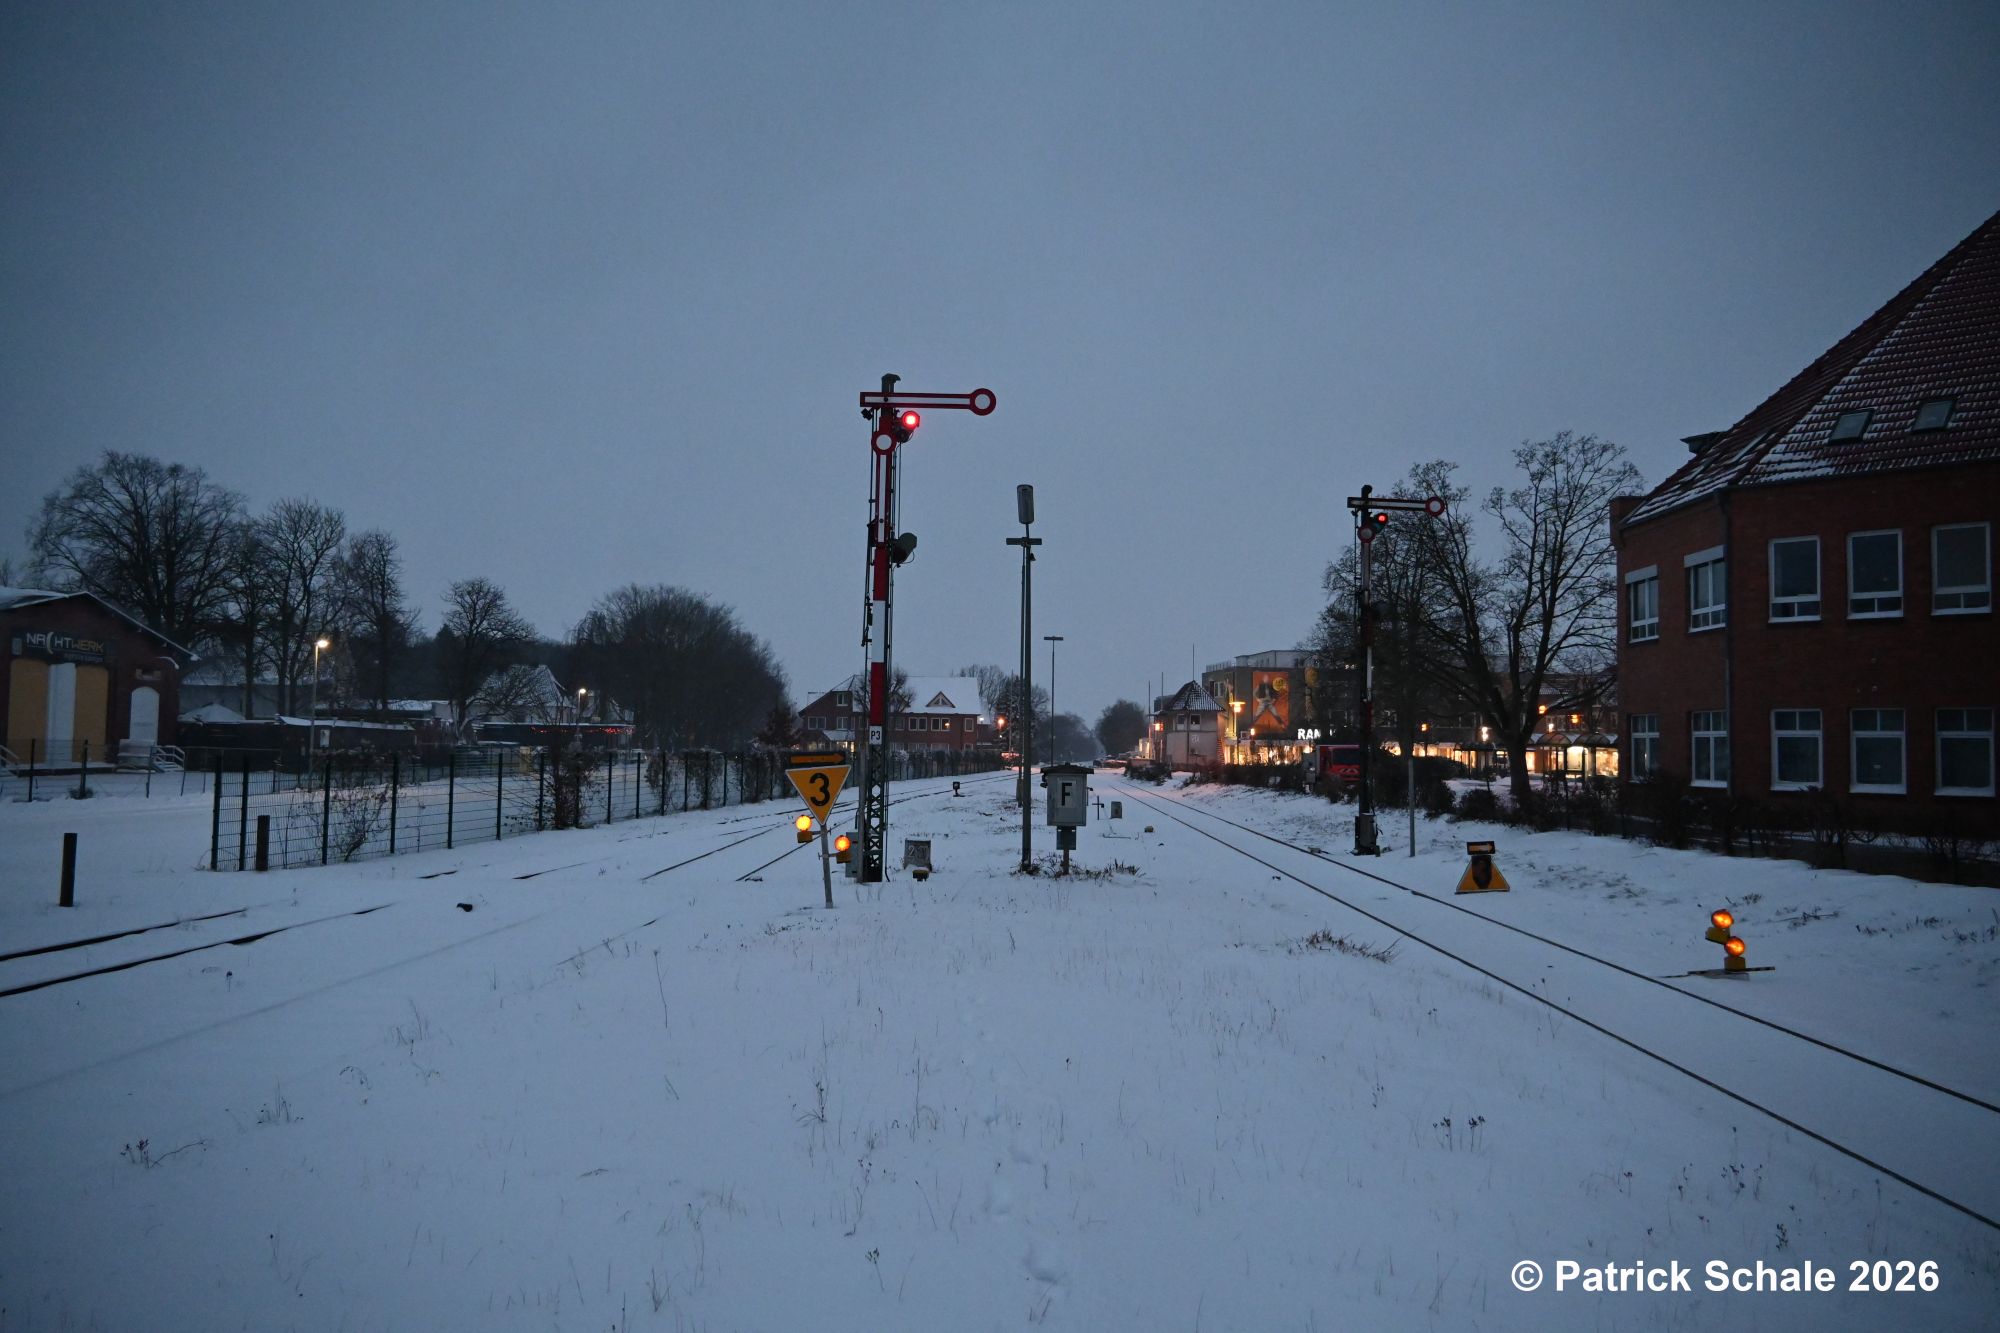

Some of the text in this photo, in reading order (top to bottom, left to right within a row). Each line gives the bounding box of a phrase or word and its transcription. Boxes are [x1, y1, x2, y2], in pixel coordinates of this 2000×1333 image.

[871, 730, 881, 740] P3
[809, 772, 830, 807] 3
[1061, 782, 1072, 806] F
